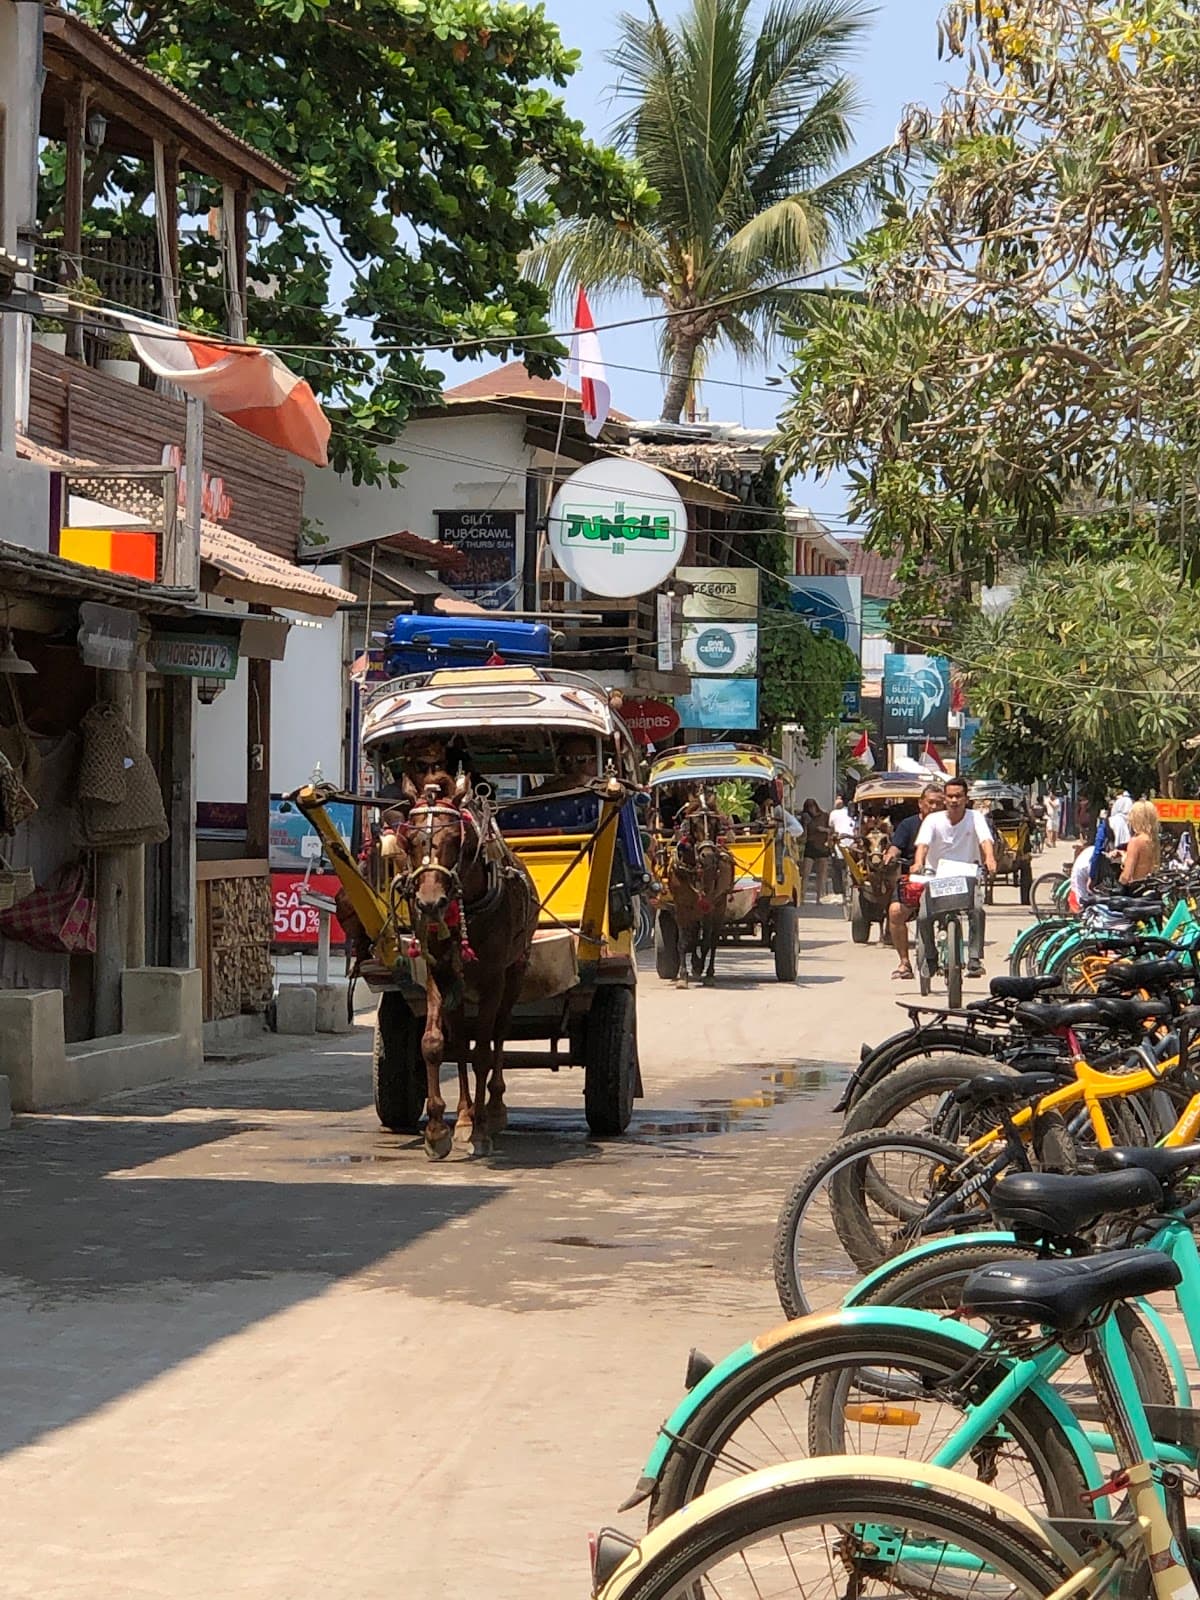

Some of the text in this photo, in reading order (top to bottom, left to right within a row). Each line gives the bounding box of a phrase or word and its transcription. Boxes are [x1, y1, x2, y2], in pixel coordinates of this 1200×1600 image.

[566, 513, 670, 541] JUNGLE
[444, 528, 512, 540] PUB CRAWL
[167, 640, 218, 668] HOMESTAY
[219, 646, 229, 668] 2
[699, 645, 732, 654] CENTRAL
[891, 685, 915, 693] BLUE
[885, 696, 920, 705] MARLIN
[891, 708, 915, 717] DIVE
